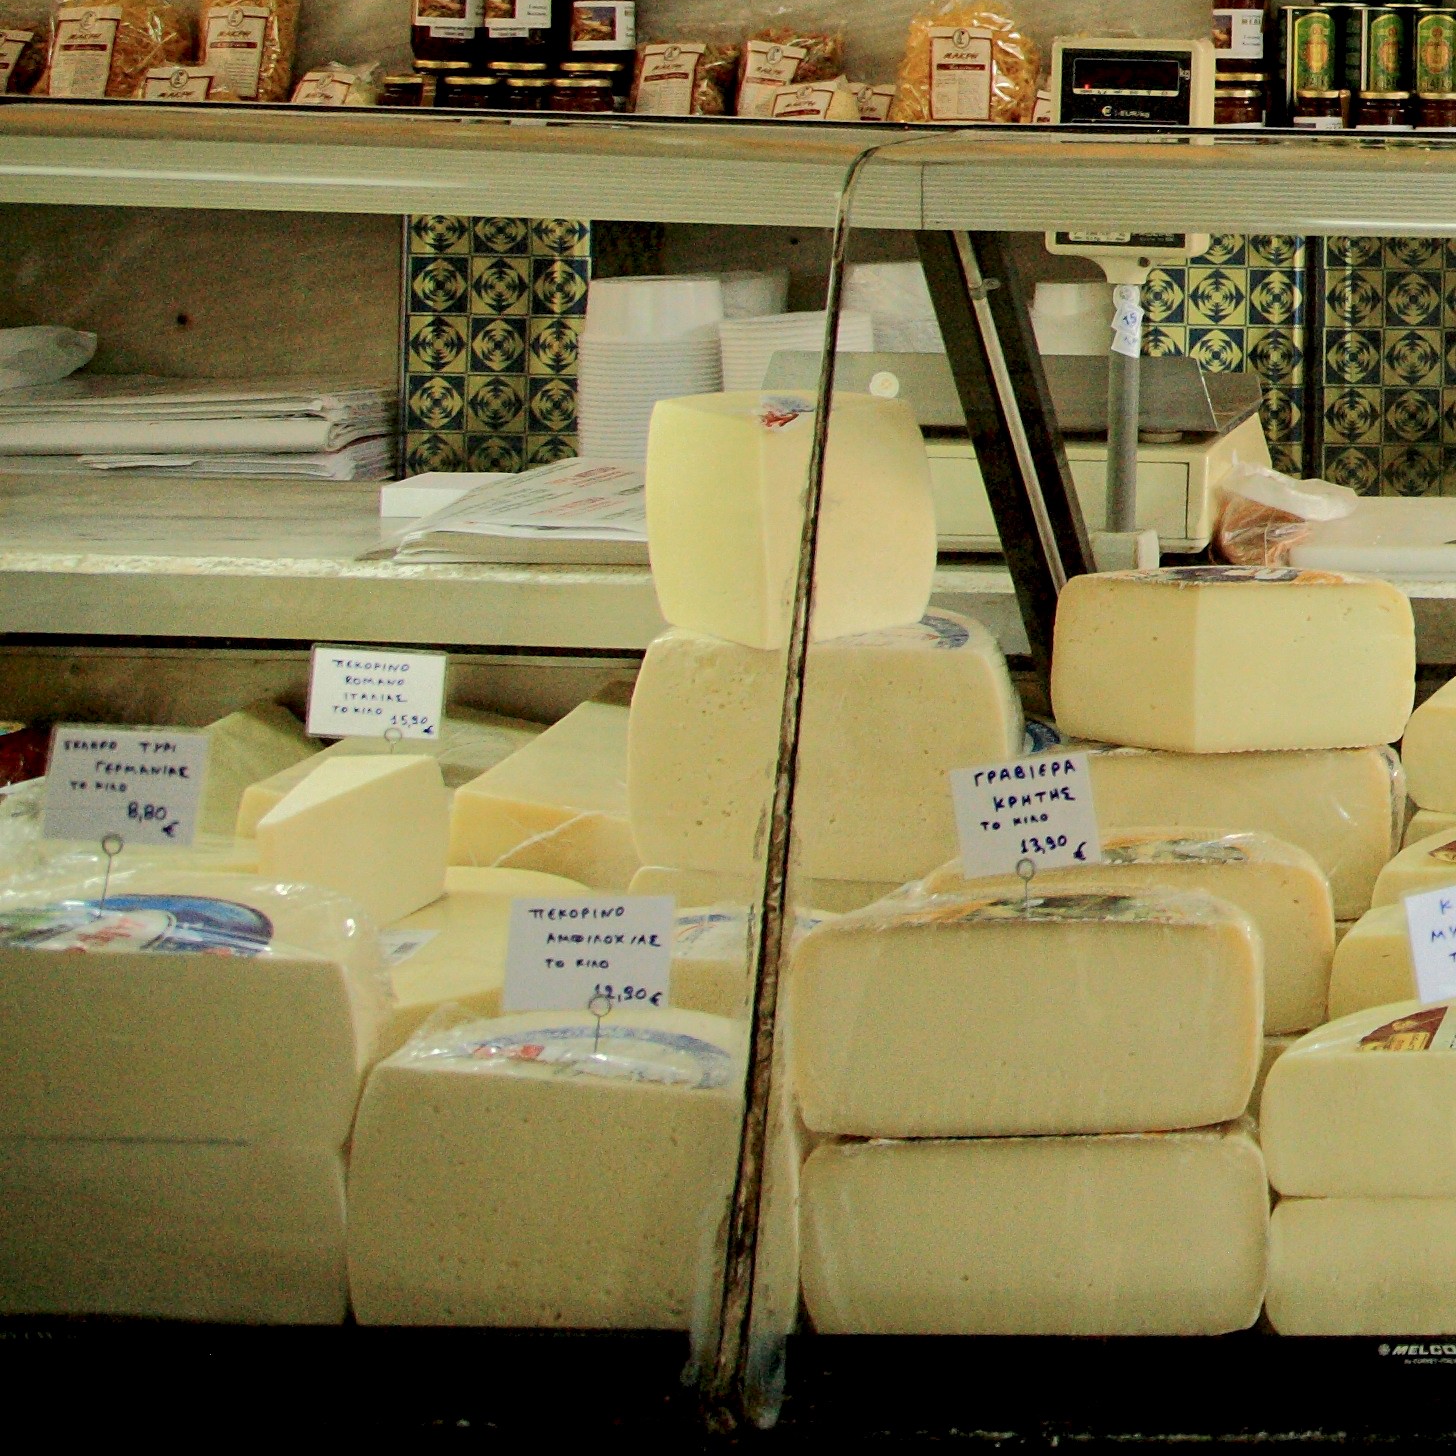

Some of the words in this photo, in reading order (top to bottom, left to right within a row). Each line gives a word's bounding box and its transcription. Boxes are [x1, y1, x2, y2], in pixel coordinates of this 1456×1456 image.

[974, 760, 1075, 786] ΓΡΑΒΙΕΡΑ
[993, 786, 1076, 811] ΚΡΗΤΗΣ
[980, 822, 1001, 831] ΤΟ
[1013, 813, 1048, 826] ΚΙΛΟ
[529, 906, 624, 920] ΠΕΚΟΡΙΝΟ
[546, 933, 661, 947] ΑΜΦΙΛΟΧΙΑΣ
[545, 958, 564, 969] ΤΟ
[576, 959, 609, 969] ΚΙΛΟ
